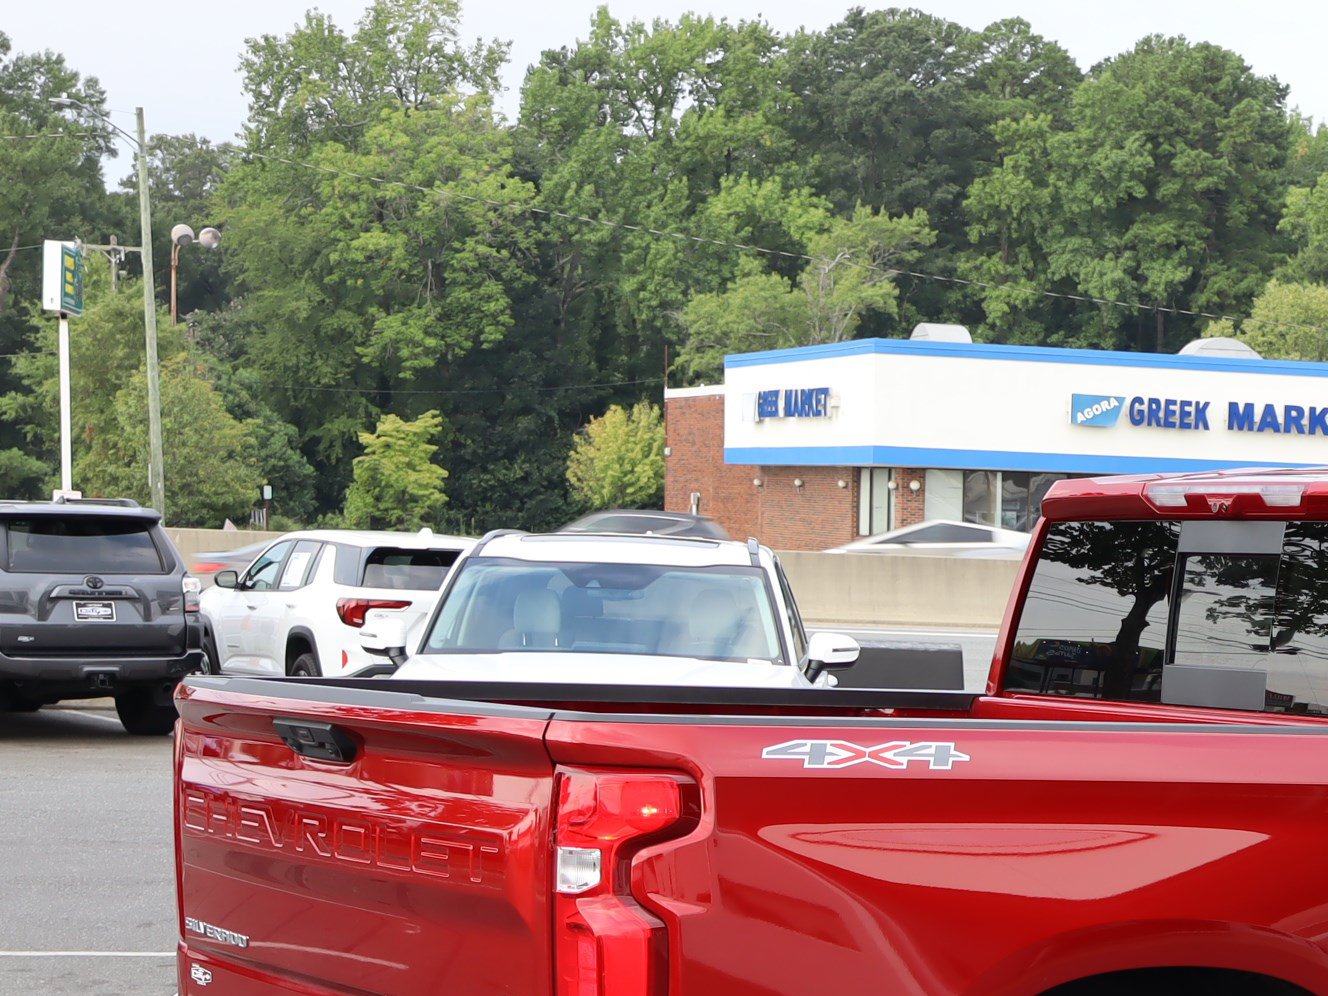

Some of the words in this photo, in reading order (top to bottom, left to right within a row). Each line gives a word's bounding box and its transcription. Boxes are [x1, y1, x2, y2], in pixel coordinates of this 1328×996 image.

[1076, 397, 1120, 424] AGORA
[1128, 396, 1210, 431] GREEK
[183, 788, 500, 883] CHEVROLET
[185, 916, 250, 948] SILVERADO
